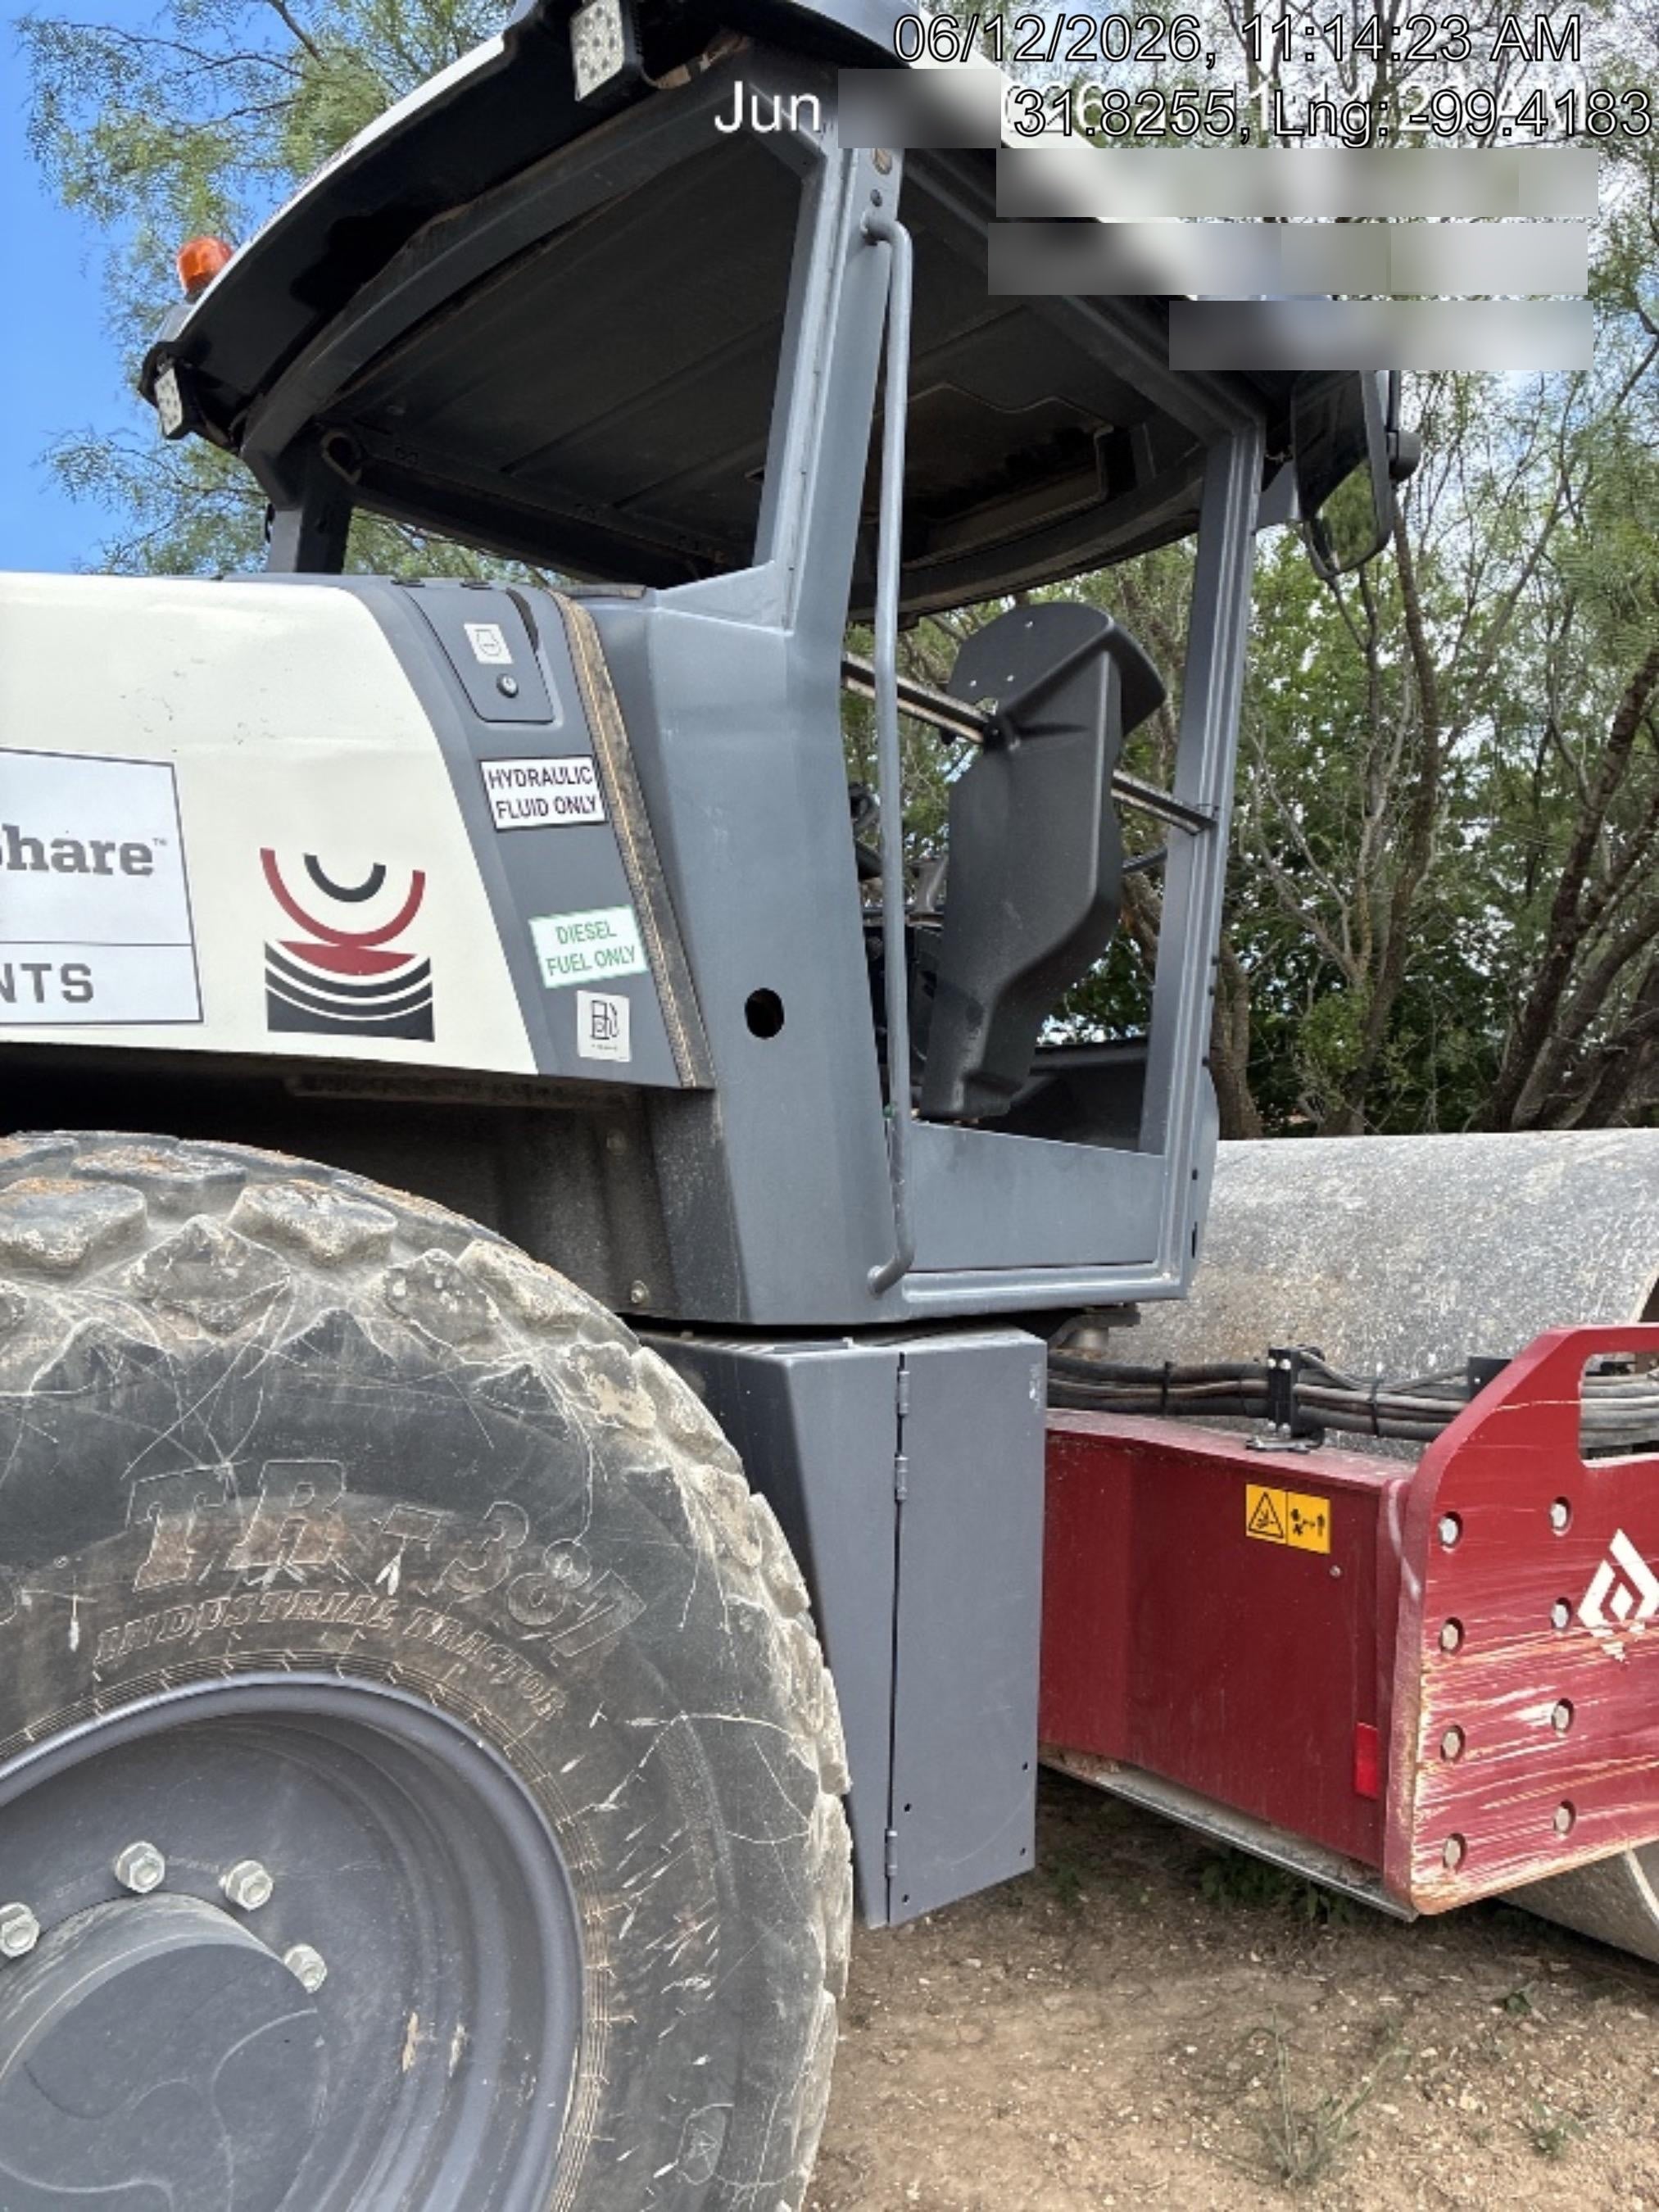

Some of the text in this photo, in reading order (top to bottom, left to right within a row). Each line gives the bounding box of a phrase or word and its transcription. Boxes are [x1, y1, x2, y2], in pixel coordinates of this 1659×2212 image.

[487, 765, 593, 789] HYDRAULIC
[496, 794, 596, 819] FLUID ONLY
[0, 823, 155, 876] hare
[555, 920, 618, 945] DIESEL
[545, 945, 636, 977] FUEL ONLY
